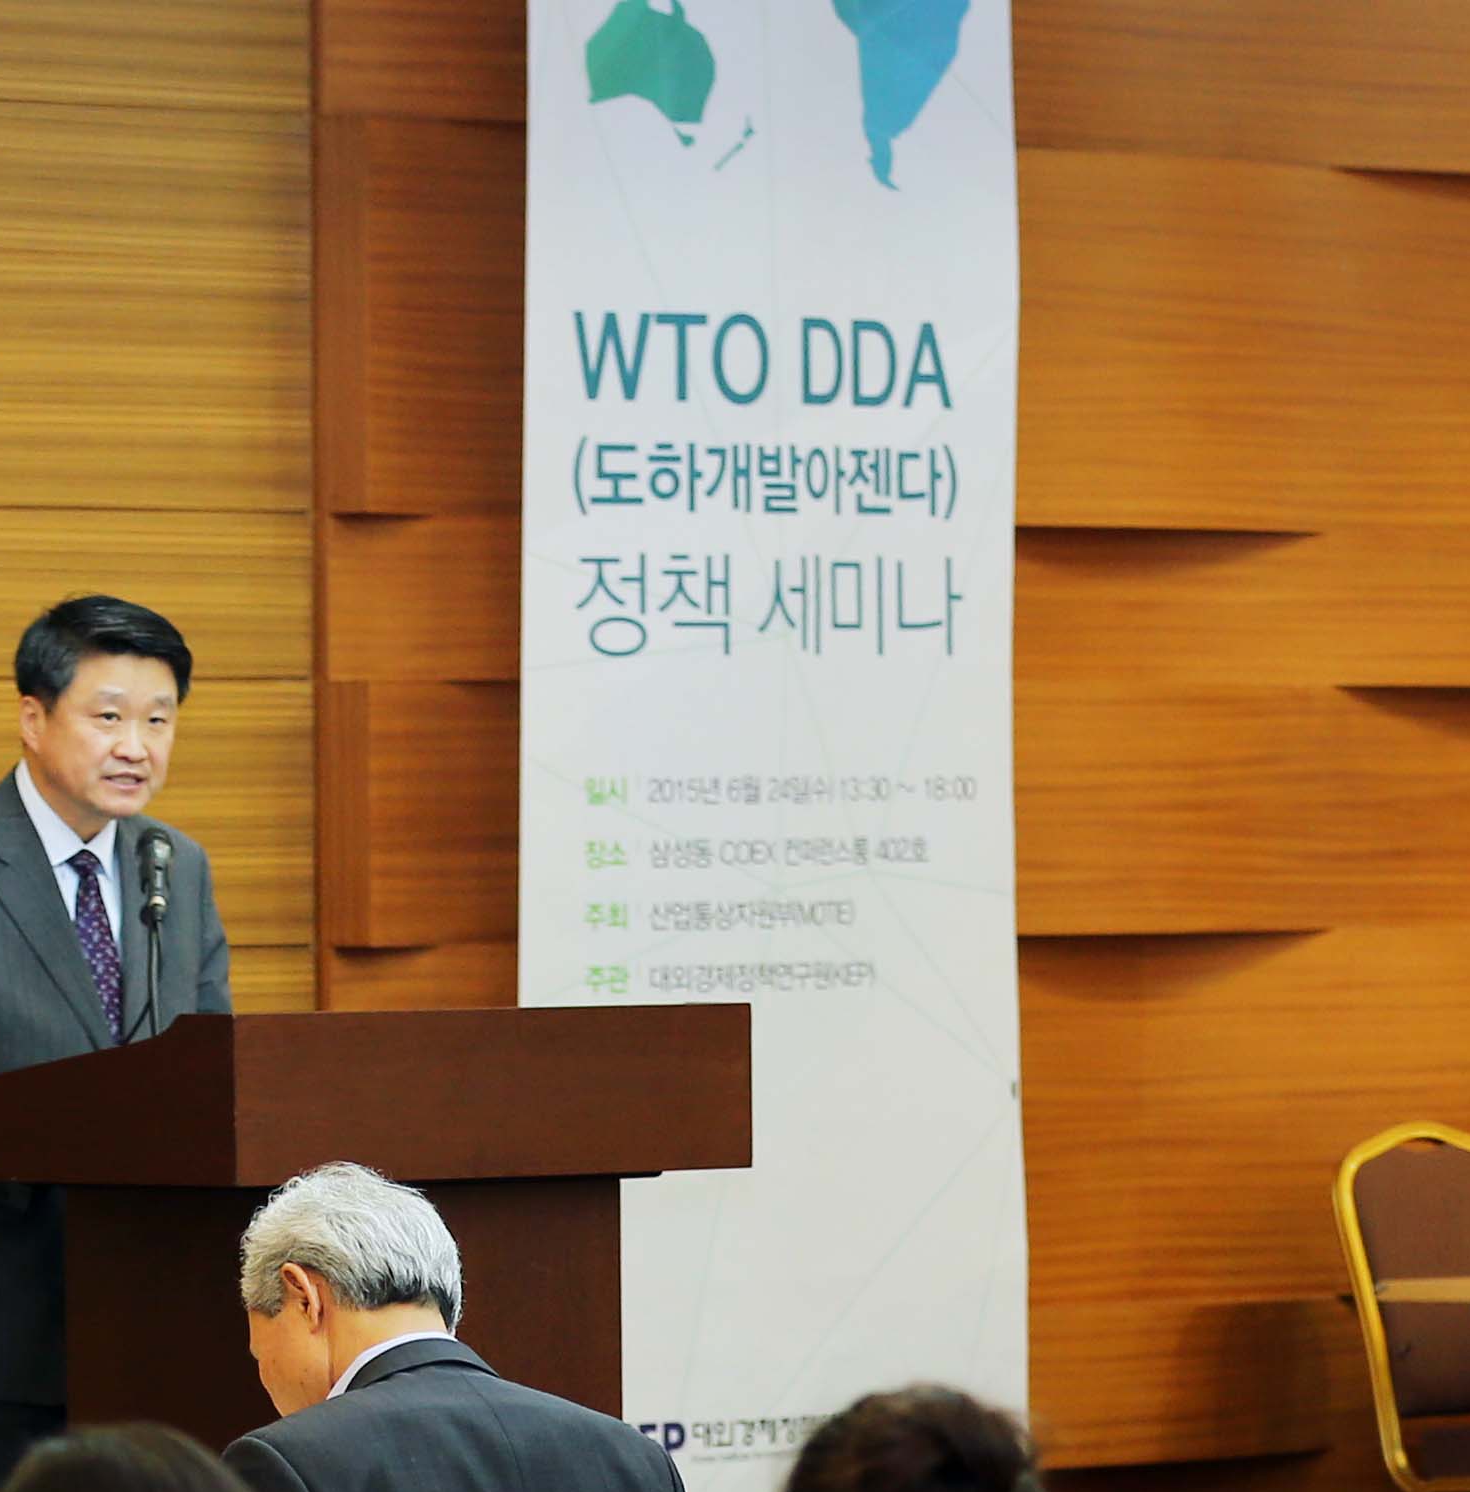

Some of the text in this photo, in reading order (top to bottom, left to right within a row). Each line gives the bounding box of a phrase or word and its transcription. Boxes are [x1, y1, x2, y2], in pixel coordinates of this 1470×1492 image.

[574, 311, 952, 409] WTO DDA
[574, 435, 957, 520] (도하개발아젠다)
[576, 552, 963, 657] 정책 세미나
[585, 776, 627, 805] 일시
[648, 776, 721, 805] 2015년
[727, 774, 761, 805] 6월
[924, 776, 978, 802] 18:00
[585, 840, 627, 870] 장소
[649, 839, 713, 869] 삼성동
[719, 840, 777, 866] COEX
[585, 902, 628, 929] 주최
[586, 965, 629, 994] 주관
